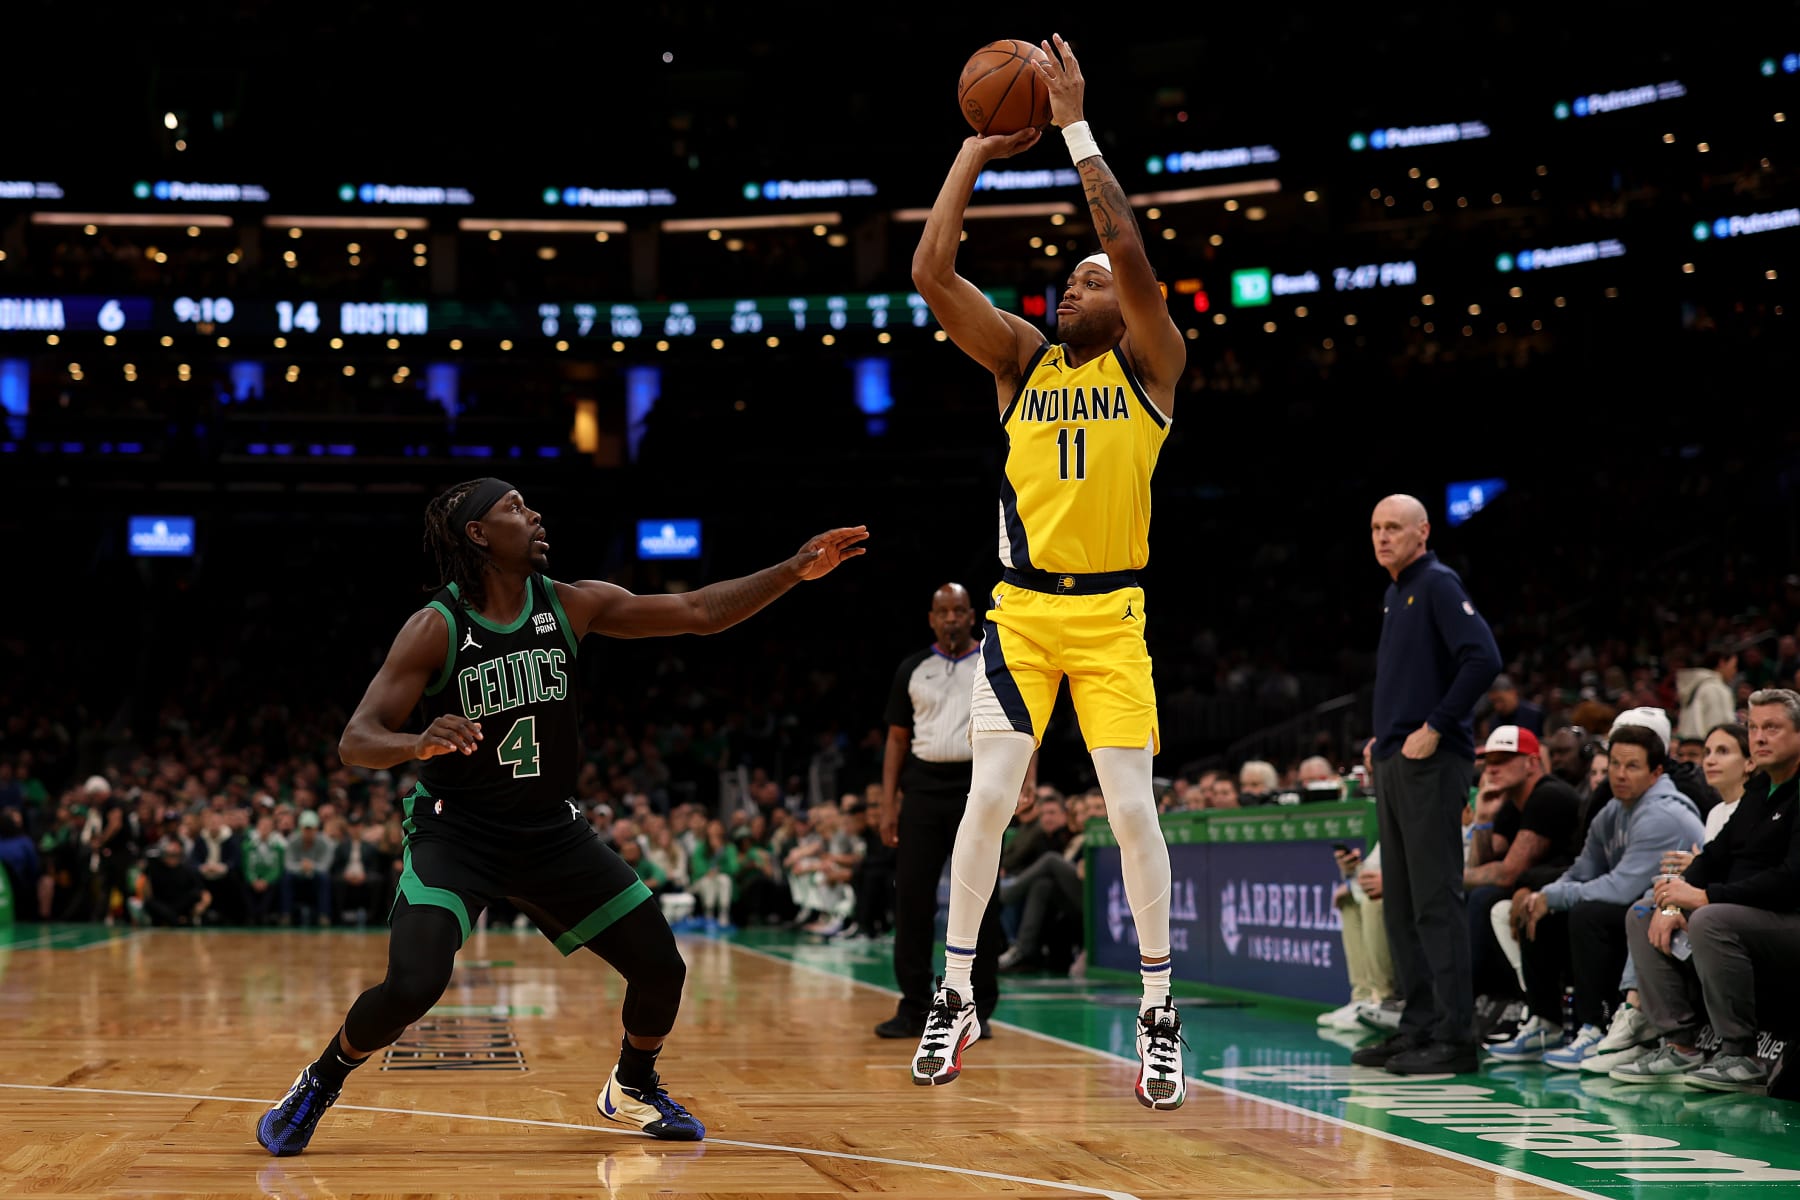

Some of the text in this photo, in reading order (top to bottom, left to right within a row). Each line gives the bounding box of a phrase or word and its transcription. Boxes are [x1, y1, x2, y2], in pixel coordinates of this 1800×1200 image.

[98, 299, 125, 331] 6
[174, 297, 234, 323] 9:10
[276, 301, 428, 334] 14 BOSTON
[1020, 386, 1130, 423] INDIANA
[1056, 427, 1086, 480] 11
[532, 612, 556, 626] VISTA
[535, 622, 557, 635] PRINT
[458, 649, 567, 720] CELTICS
[497, 716, 540, 779] 4
[1237, 879, 1344, 931] ARBELLA
[1248, 935, 1332, 967] INSURANCE
